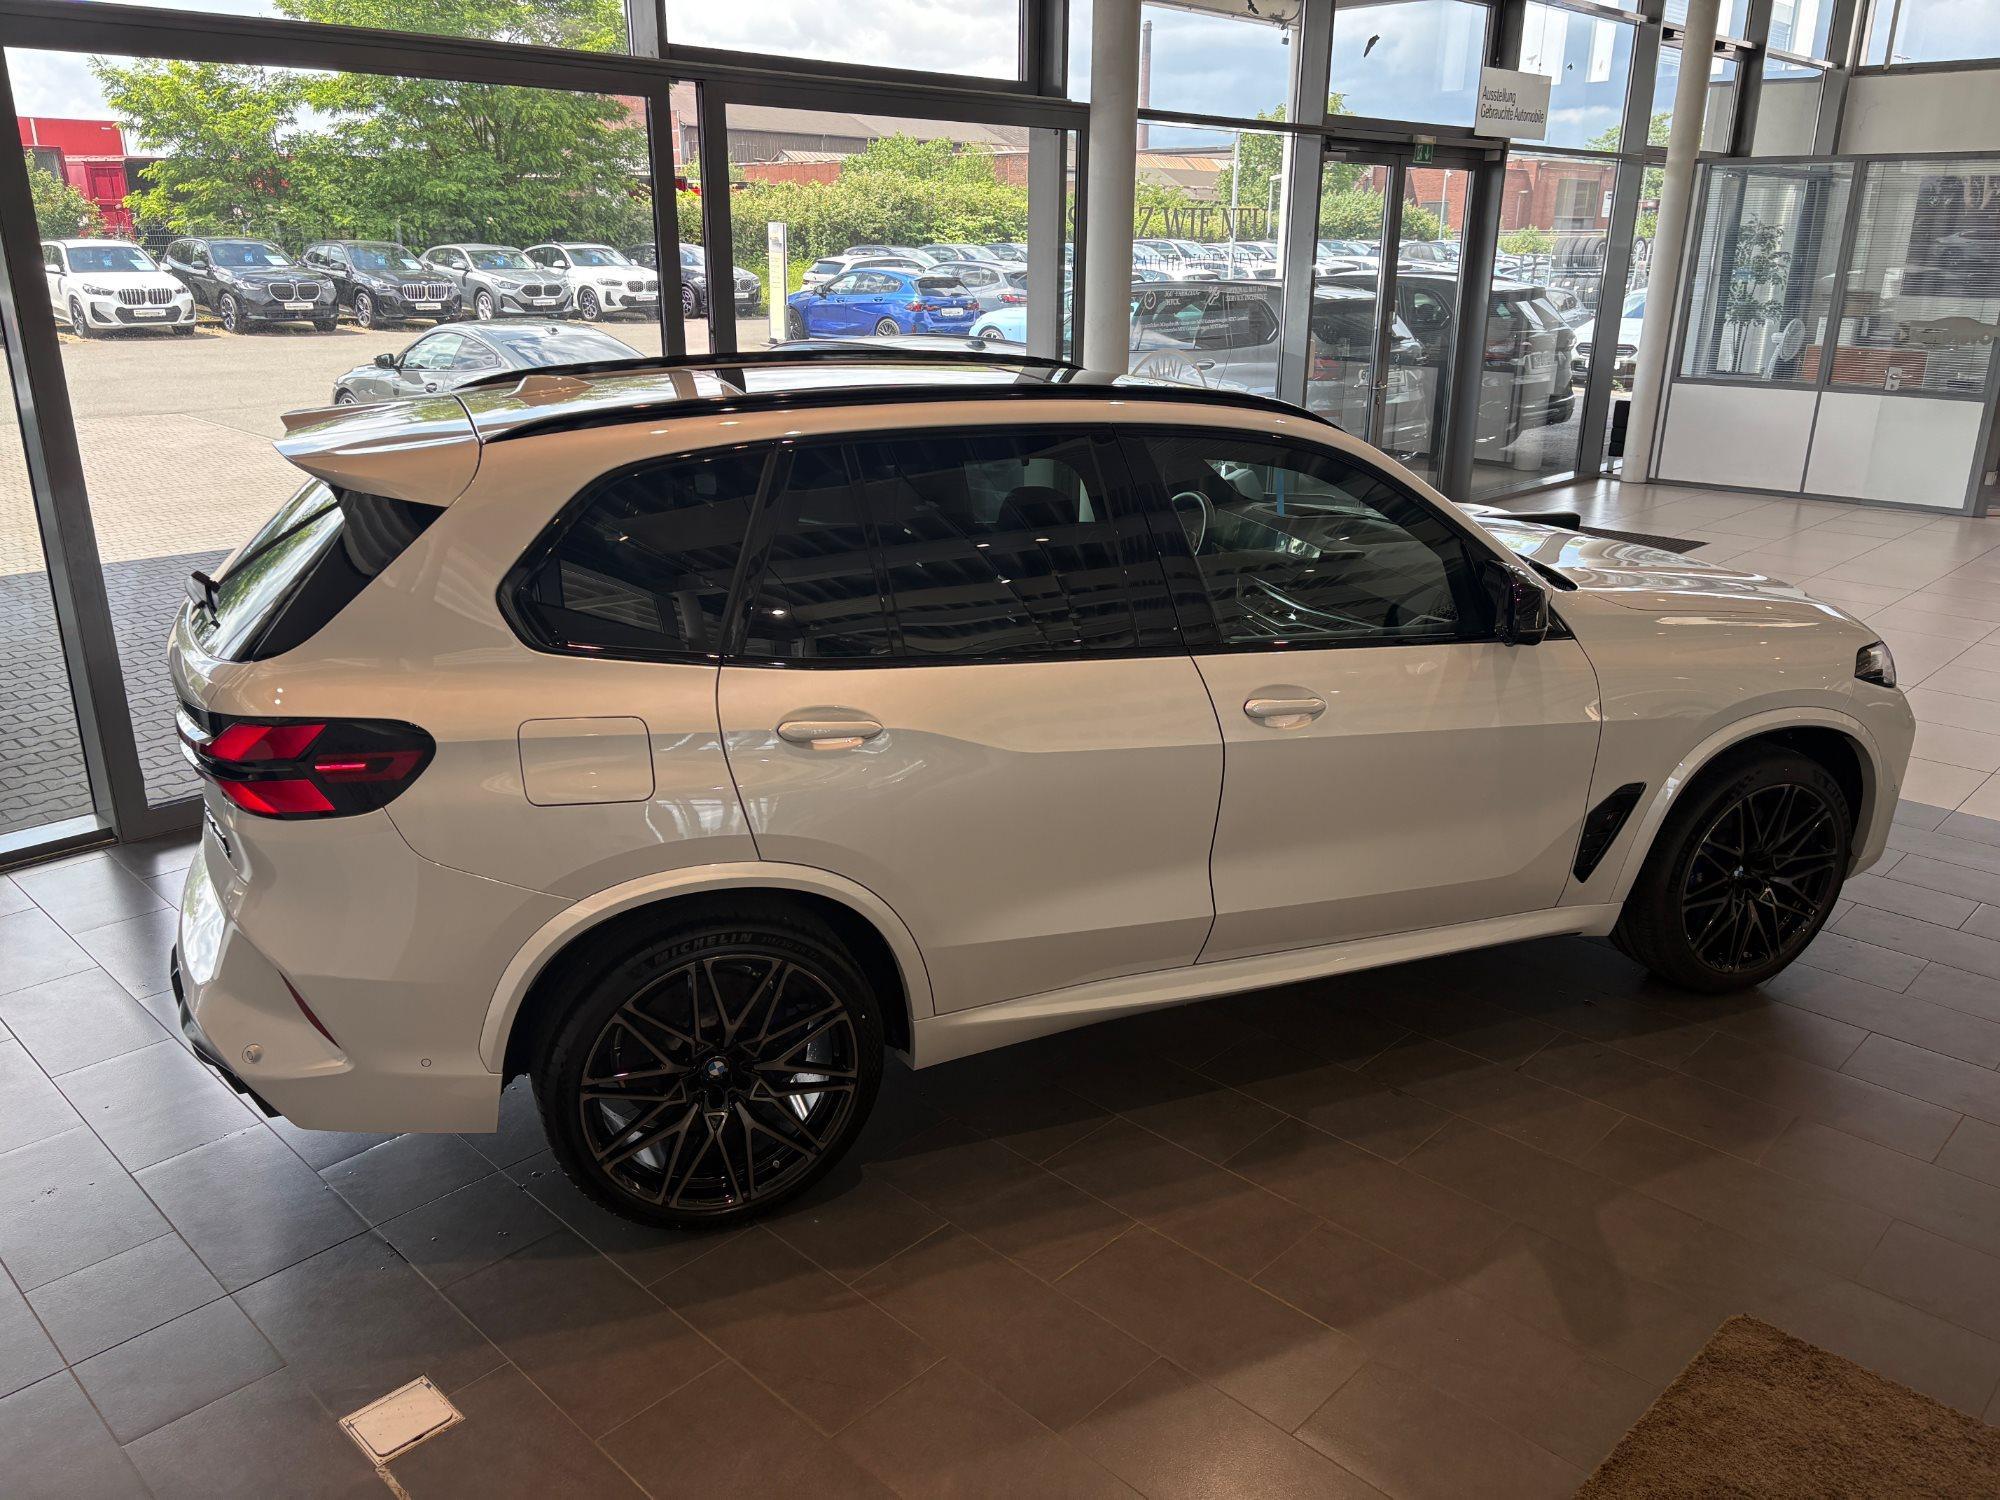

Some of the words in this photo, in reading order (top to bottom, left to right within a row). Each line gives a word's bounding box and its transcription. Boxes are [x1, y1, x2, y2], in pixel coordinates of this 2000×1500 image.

[1481, 86, 1516, 106] Ausstellung
[1481, 103, 1514, 121] Gebrauchte
[1514, 107, 1544, 124] Automobile
[1149, 358, 1183, 380] MINI
[653, 932, 754, 966] MICHELIN
